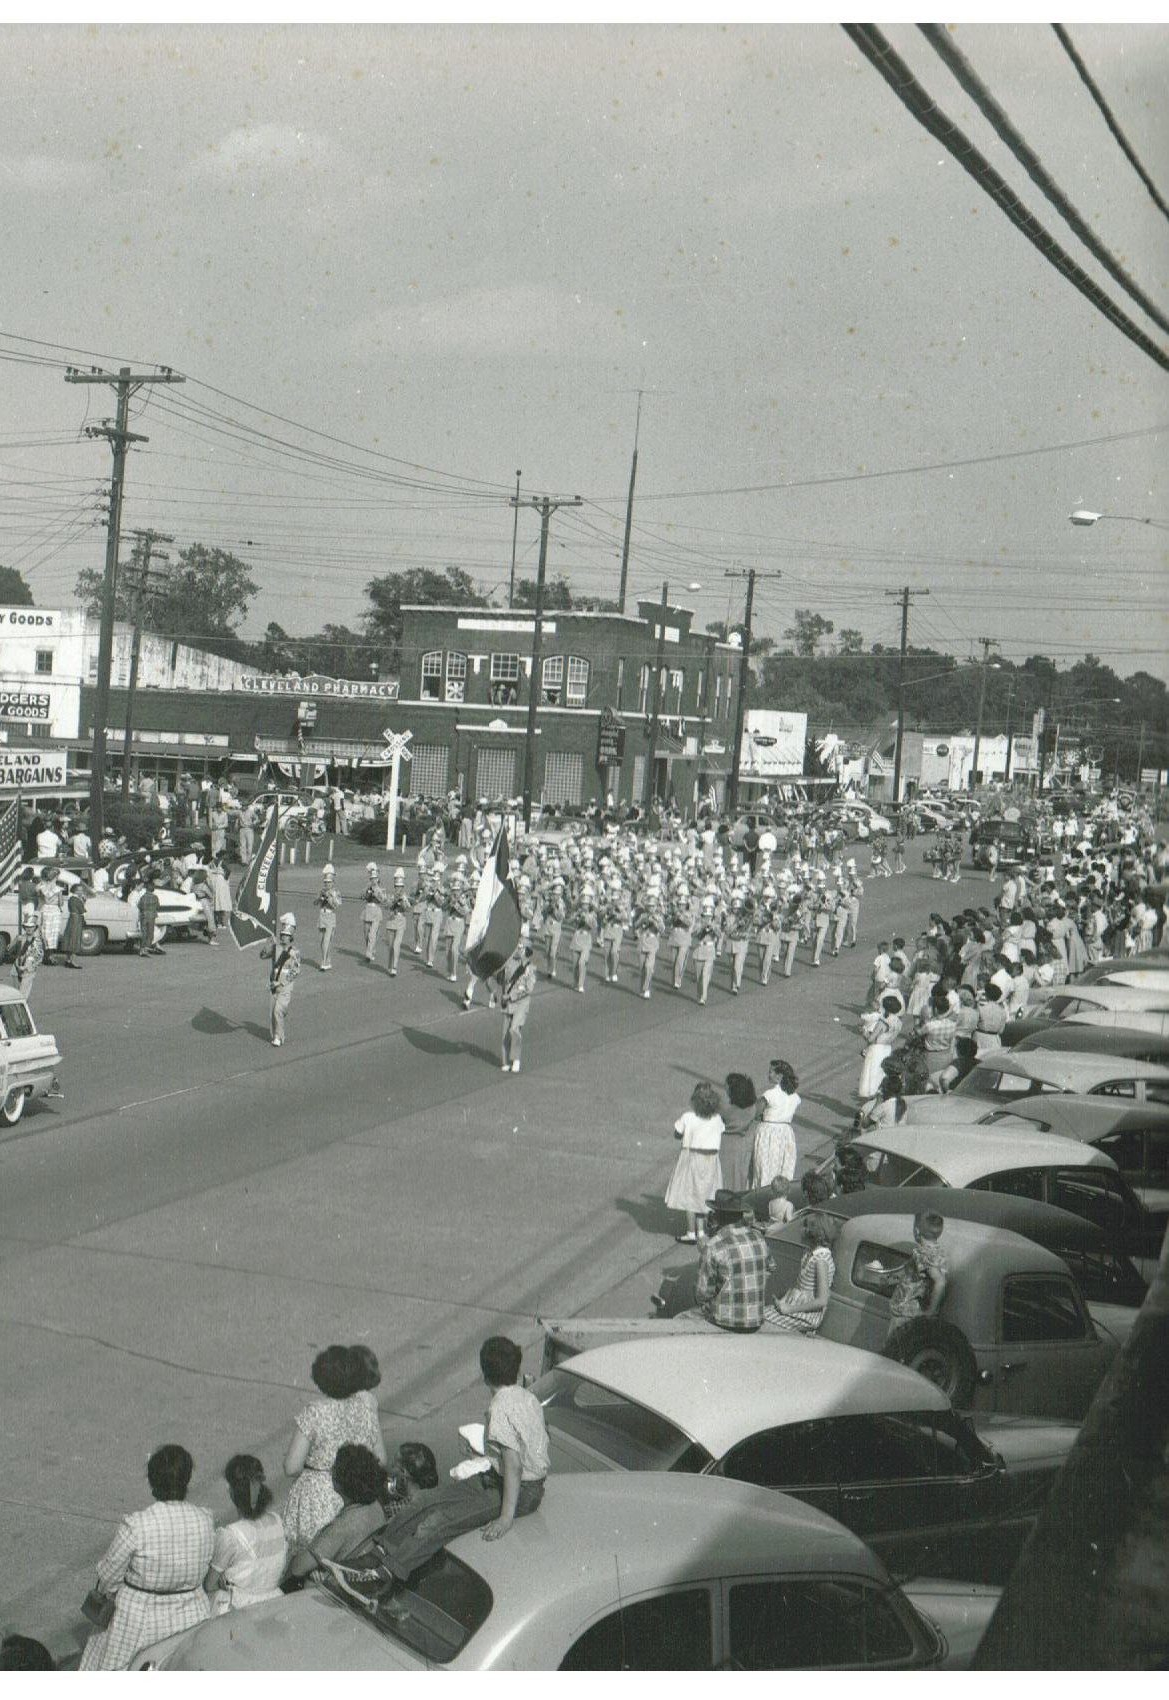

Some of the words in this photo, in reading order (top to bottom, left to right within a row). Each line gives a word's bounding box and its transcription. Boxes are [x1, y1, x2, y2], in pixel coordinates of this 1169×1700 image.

[9, 612, 53, 626] GOODS
[245, 678, 319, 692] CLEVELAND
[324, 682, 395, 696] PHARMACY
[7, 706, 48, 718] GOODS
